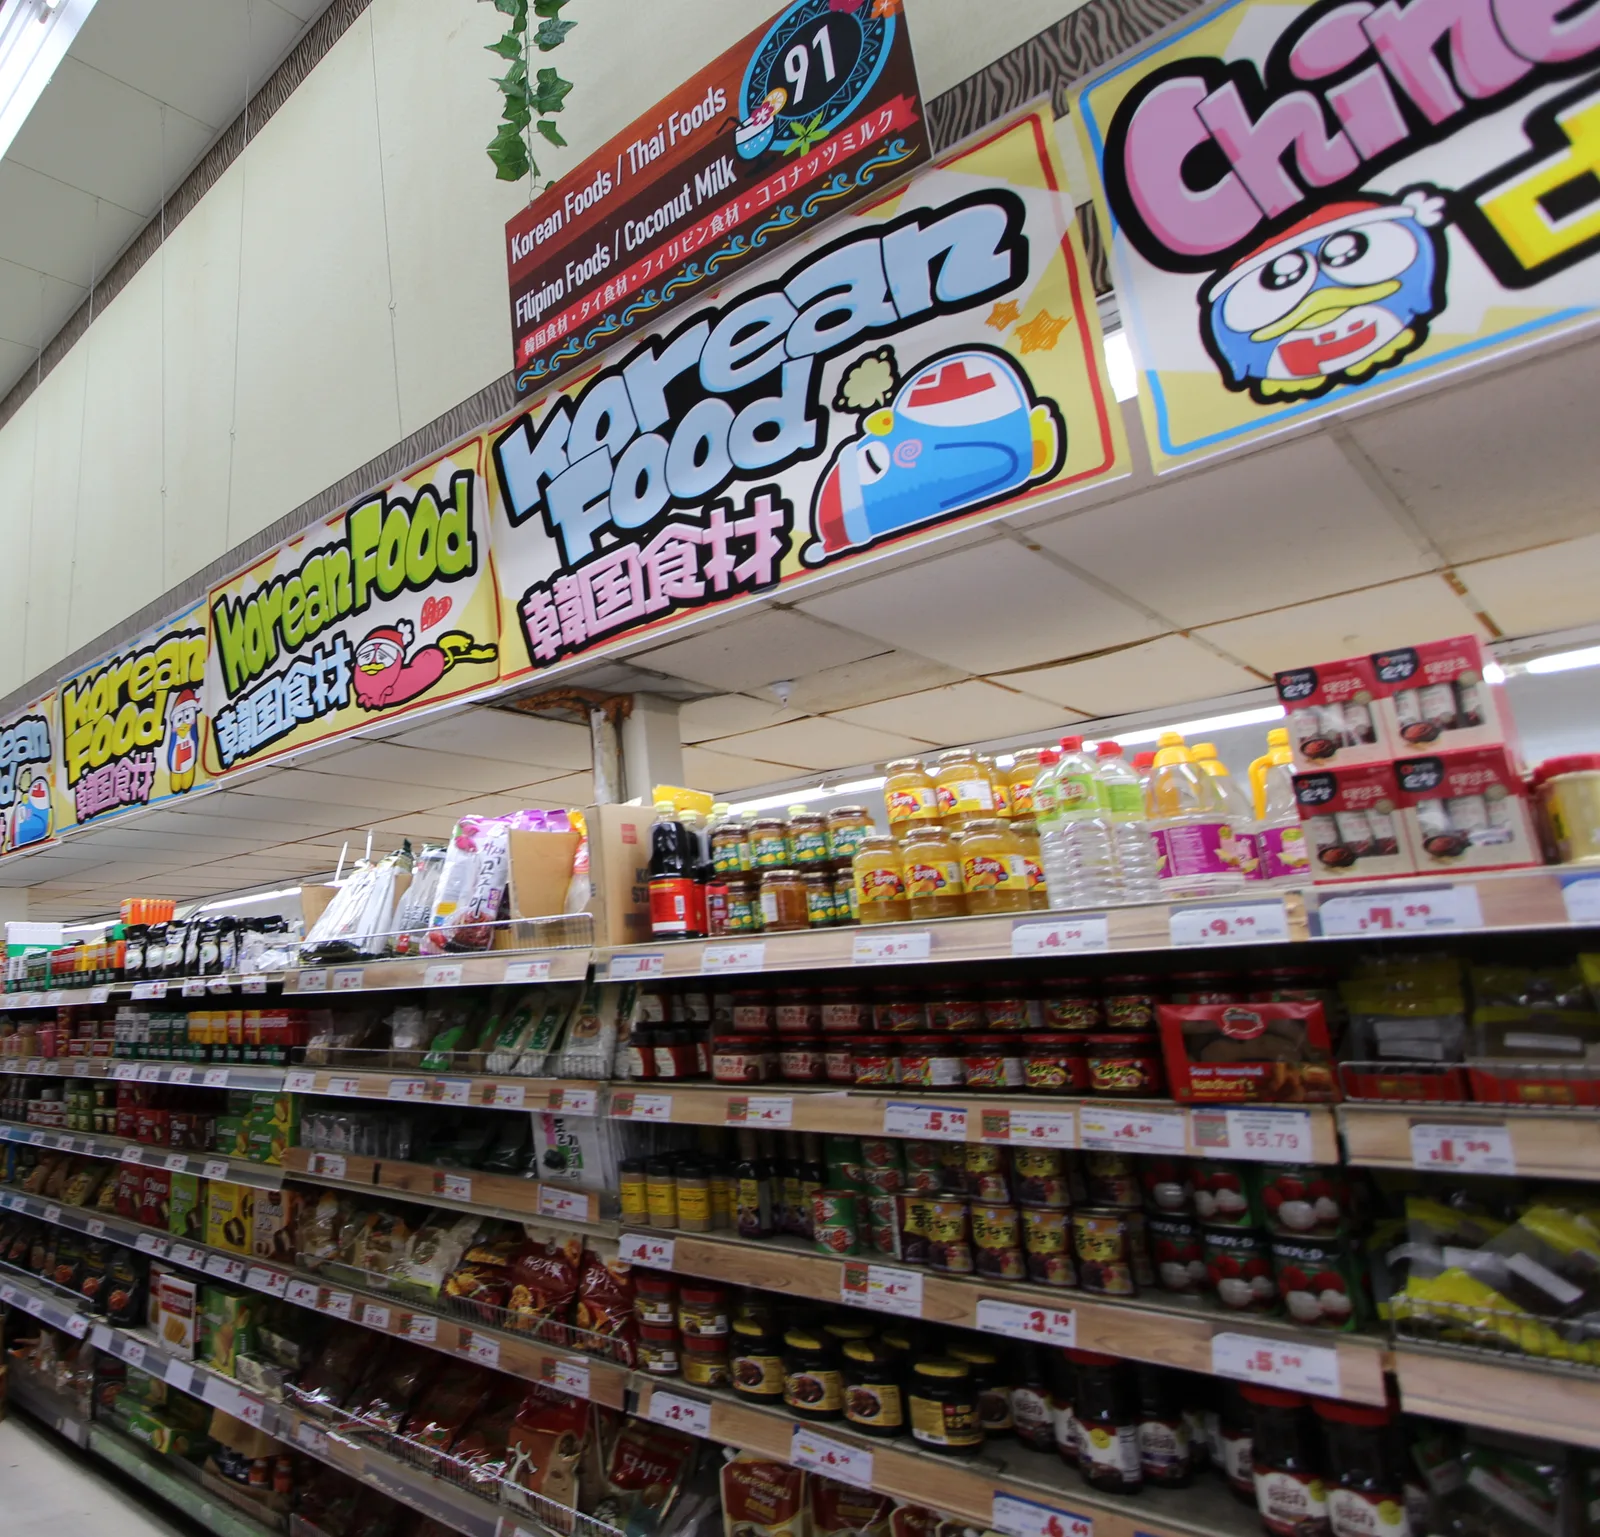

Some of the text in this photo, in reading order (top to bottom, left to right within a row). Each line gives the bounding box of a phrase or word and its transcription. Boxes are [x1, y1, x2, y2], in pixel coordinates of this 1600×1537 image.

[784, 24, 837, 107] 91
[511, 86, 727, 264] Korean Foods / Thai Foods
[516, 157, 738, 328] Filipino Foods / Coconut Milk
[499, 204, 1012, 517] Korean
[546, 355, 819, 566] Food
[213, 478, 471, 695] Korean Food
[523, 490, 786, 662] 韓国食材
[65, 634, 206, 731] Korean
[65, 688, 166, 784] Food
[216, 636, 353, 764] 韓国食材
[76, 752, 156, 821] 韓国食材
[1243, 1131, 1299, 1149] $5.79
